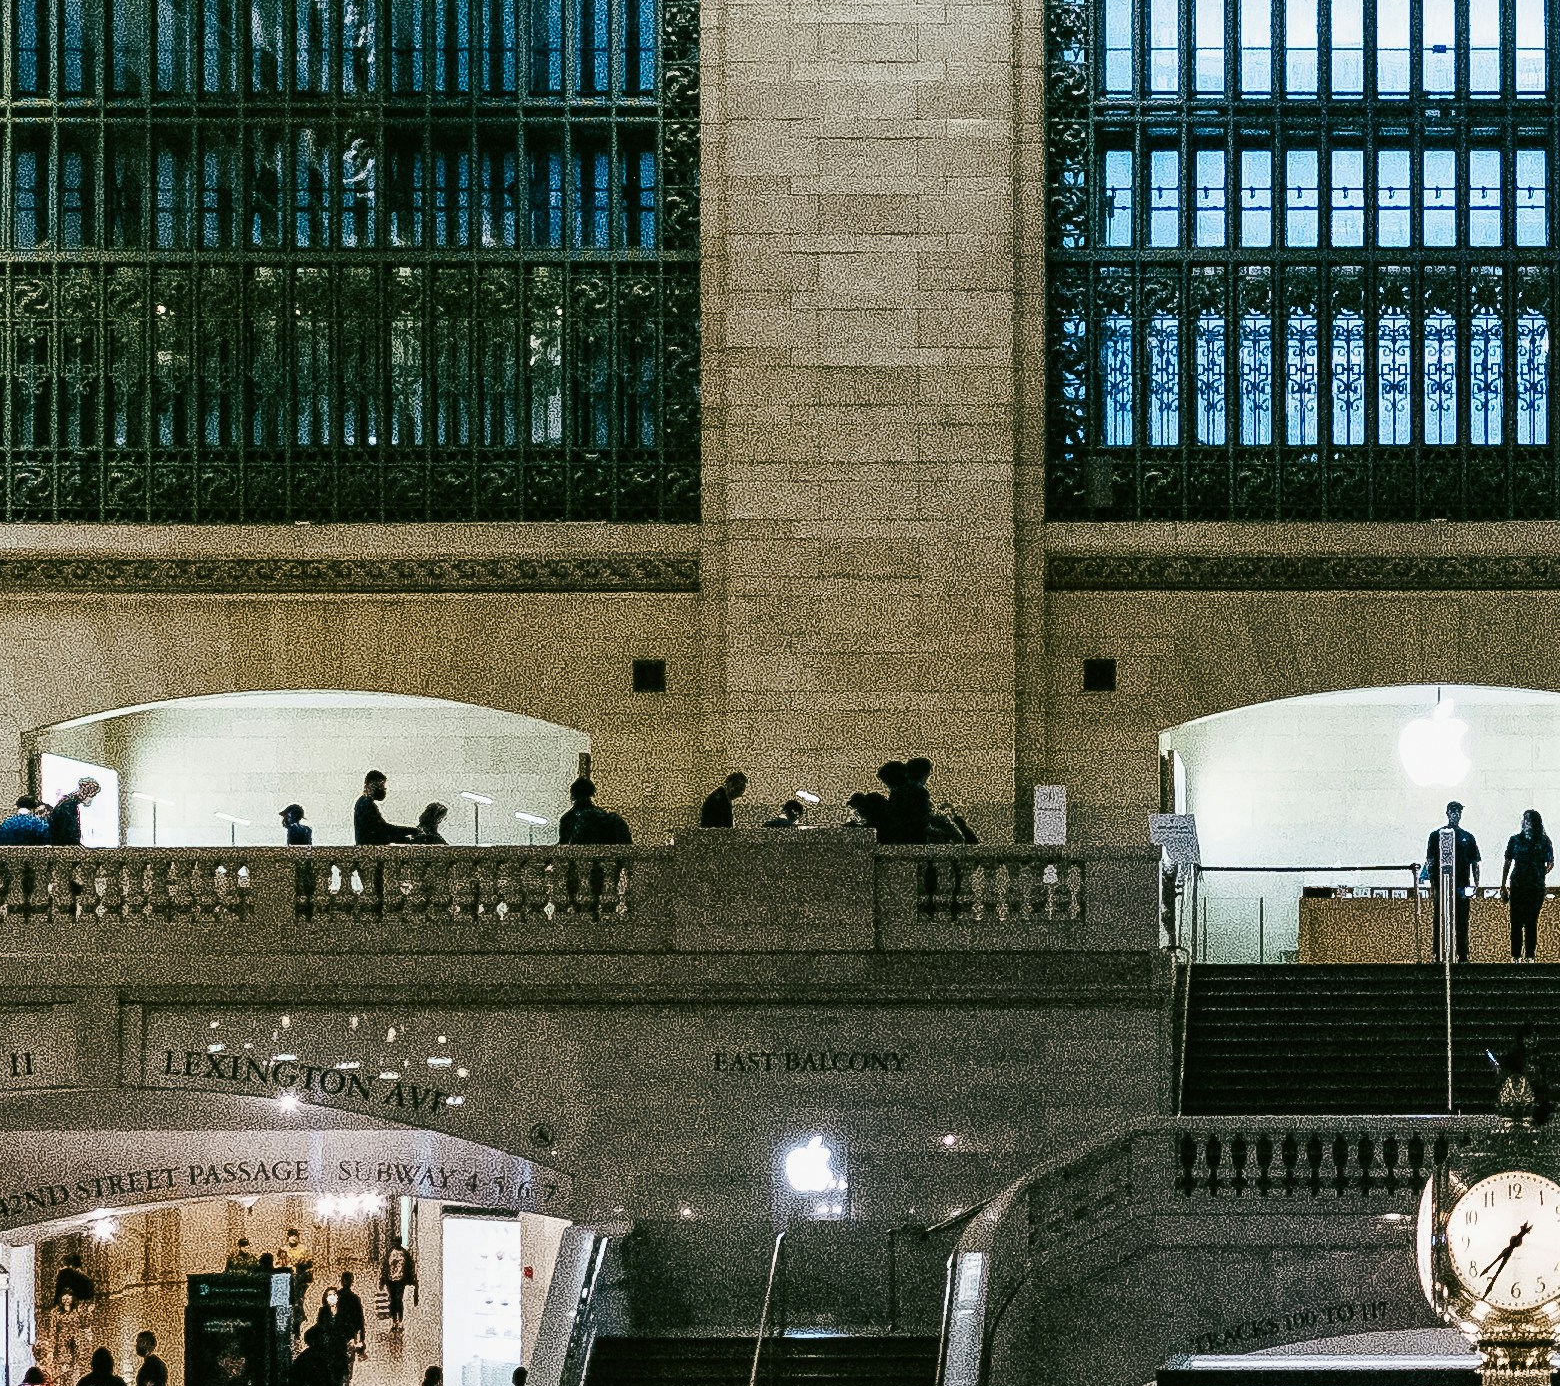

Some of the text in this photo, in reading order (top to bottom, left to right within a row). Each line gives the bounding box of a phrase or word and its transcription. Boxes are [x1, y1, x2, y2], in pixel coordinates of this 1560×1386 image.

[9, 1052, 33, 1077] 11
[714, 1051, 907, 1072] EAST BALCONY
[165, 1050, 375, 1101] LEXINGTON
[77, 1166, 180, 1198] STREET
[190, 1161, 309, 1185] PASSAGE
[339, 1161, 458, 1189] SUBWAY
[1484, 1191, 1494, 1207] 11
[1508, 1183, 1523, 1199] 12
[1539, 1191, 1544, 1205] 1
[1466, 1211, 1477, 1225] 10
[1462, 1236, 1470, 1252] 9
[1469, 1260, 1478, 1277] 8
[1511, 1282, 1521, 1298] 6
[1535, 1277, 1545, 1293] 5
[1326, 1304, 1354, 1323] TO
